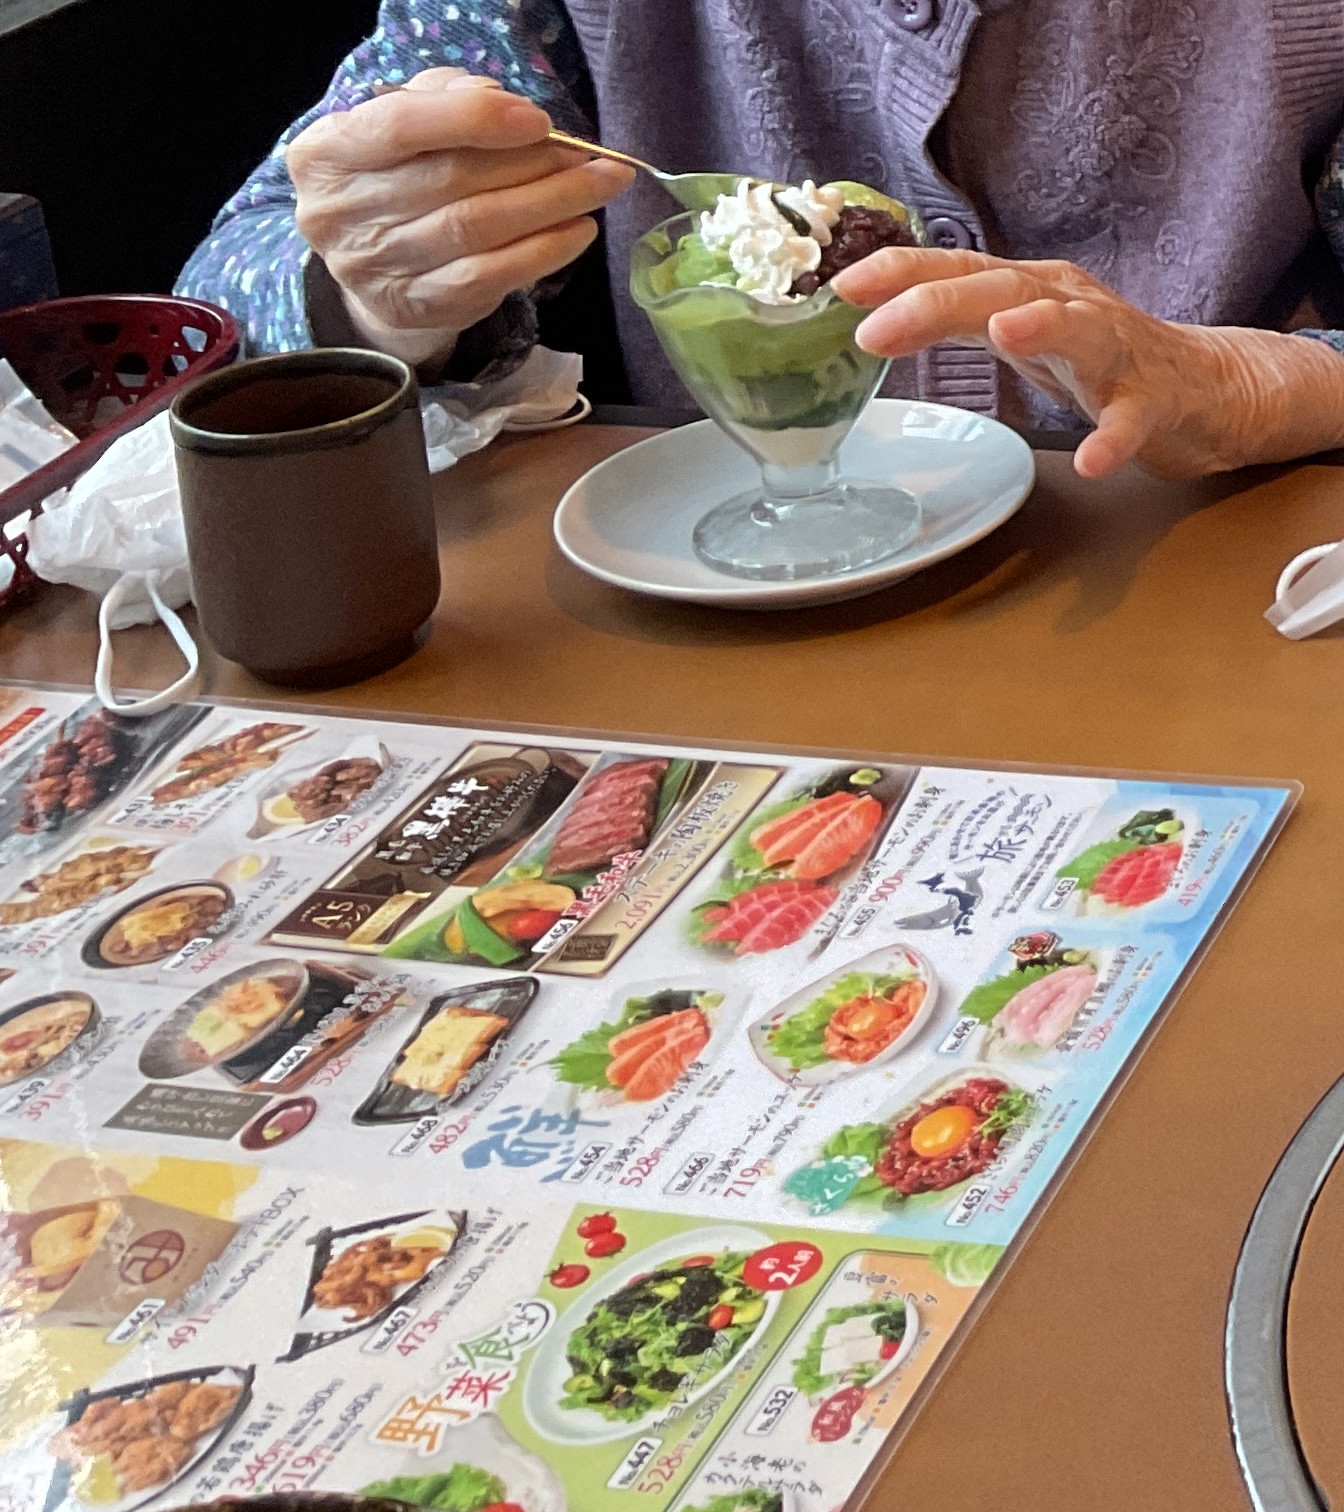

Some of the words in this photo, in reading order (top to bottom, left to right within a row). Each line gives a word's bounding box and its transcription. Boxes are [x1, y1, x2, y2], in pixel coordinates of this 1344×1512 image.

[563, 848, 644, 917] 黒毛和牛
[1044, 878, 1077, 907] No.453
[305, 900, 356, 929] A5
[946, 1019, 978, 1050] No.496
[399, 1119, 439, 1153] No.468
[591, 1060, 711, 1184] ご当地サーモンのお刺身
[458, 1103, 609, 1183] 鮮
[616, 1145, 671, 1187] 528円
[672, 1156, 710, 1191] No.466
[721, 1157, 773, 1198] 719円
[952, 1187, 988, 1223] No.452
[766, 1249, 815, 1284] 2人前
[371, 1310, 415, 1350] No.467
[389, 1310, 449, 1356] 473円
[371, 1300, 547, 1451] 野菜を食べよう
[754, 1389, 795, 1431] No.532
[227, 1437, 293, 1491] 346円
[614, 1441, 657, 1485] No.447
[635, 1442, 693, 1494] 528円
[712, 1449, 812, 1475] 小海老の
